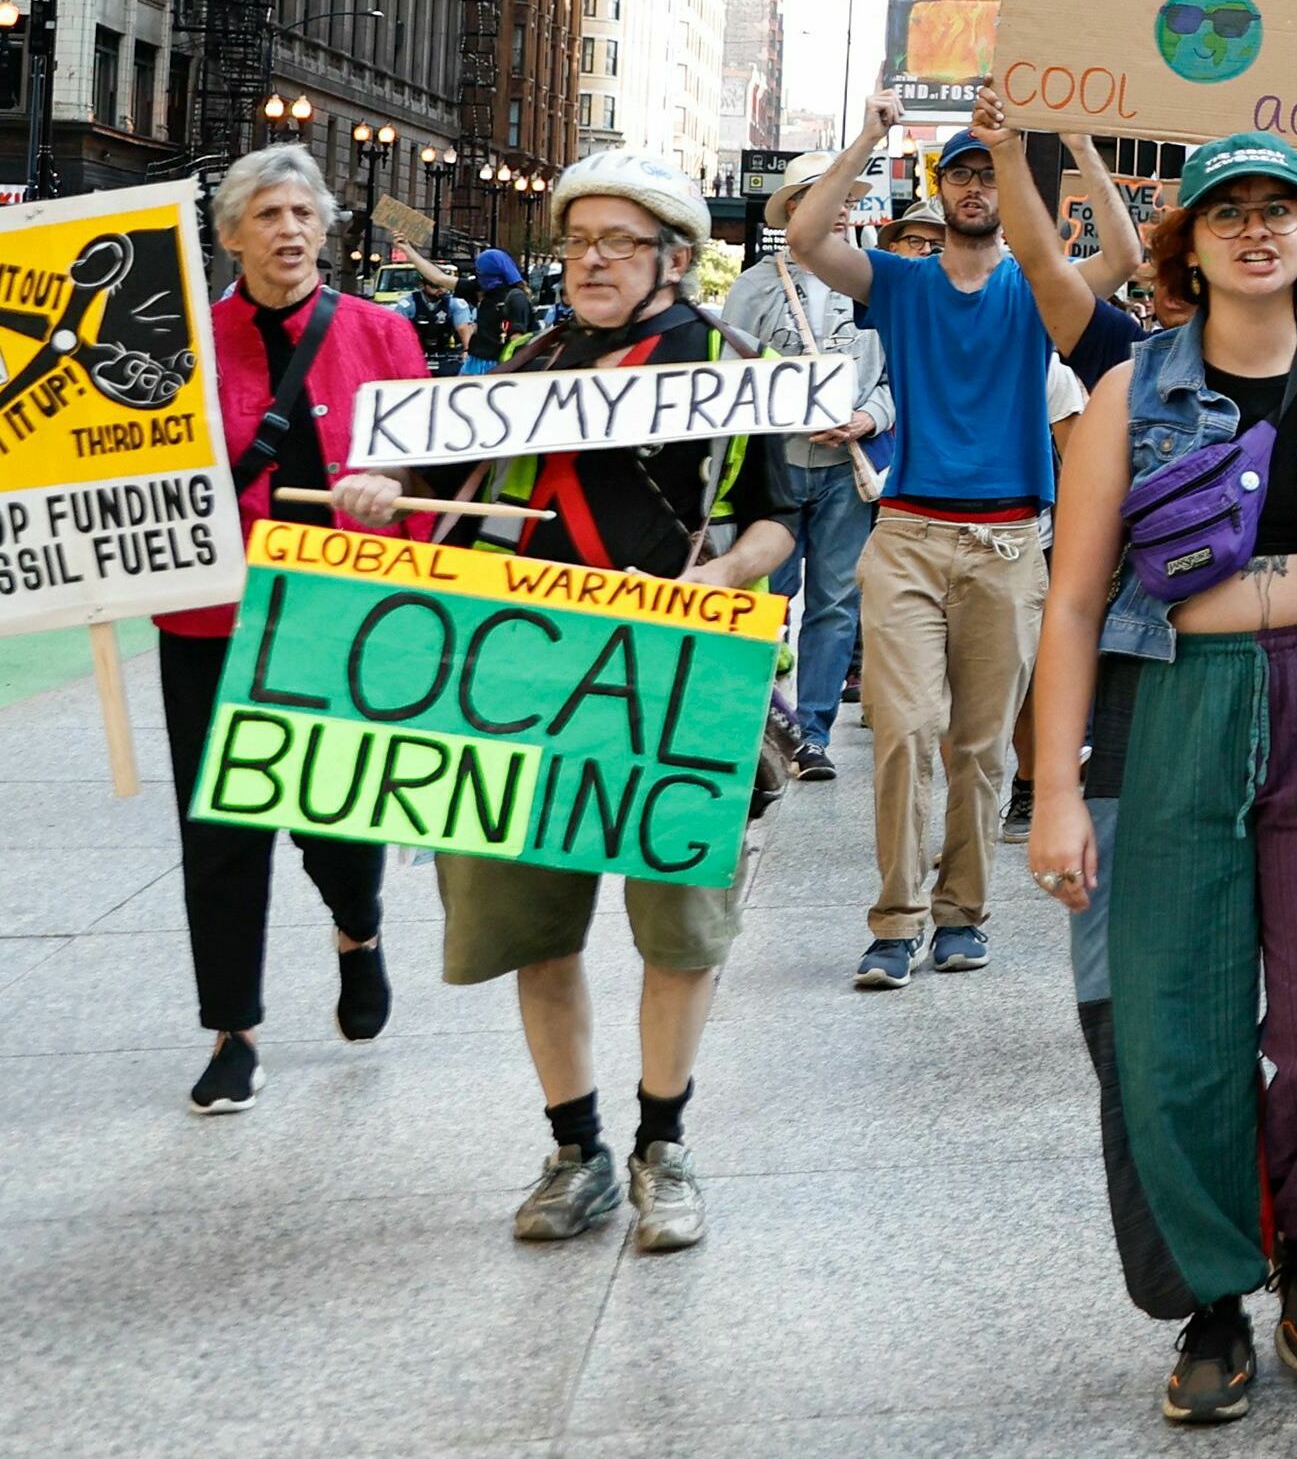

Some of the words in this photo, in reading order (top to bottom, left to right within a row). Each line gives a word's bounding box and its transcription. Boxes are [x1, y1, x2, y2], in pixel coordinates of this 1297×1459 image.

[895, 83, 929, 100] END
[20, 266, 69, 311] OUT
[28, 366, 88, 418] UP!
[367, 380, 510, 456] KISS
[527, 373, 640, 440] MY
[650, 359, 847, 435] FRACK
[150, 413, 196, 449] ACT
[46, 473, 216, 538] FUNDING
[93, 522, 218, 579] FUELS
[264, 524, 459, 582] GLOBAL
[505, 560, 756, 633] WARMING?
[248, 575, 738, 775] LOCAL
[209, 711, 722, 873] BURNING
